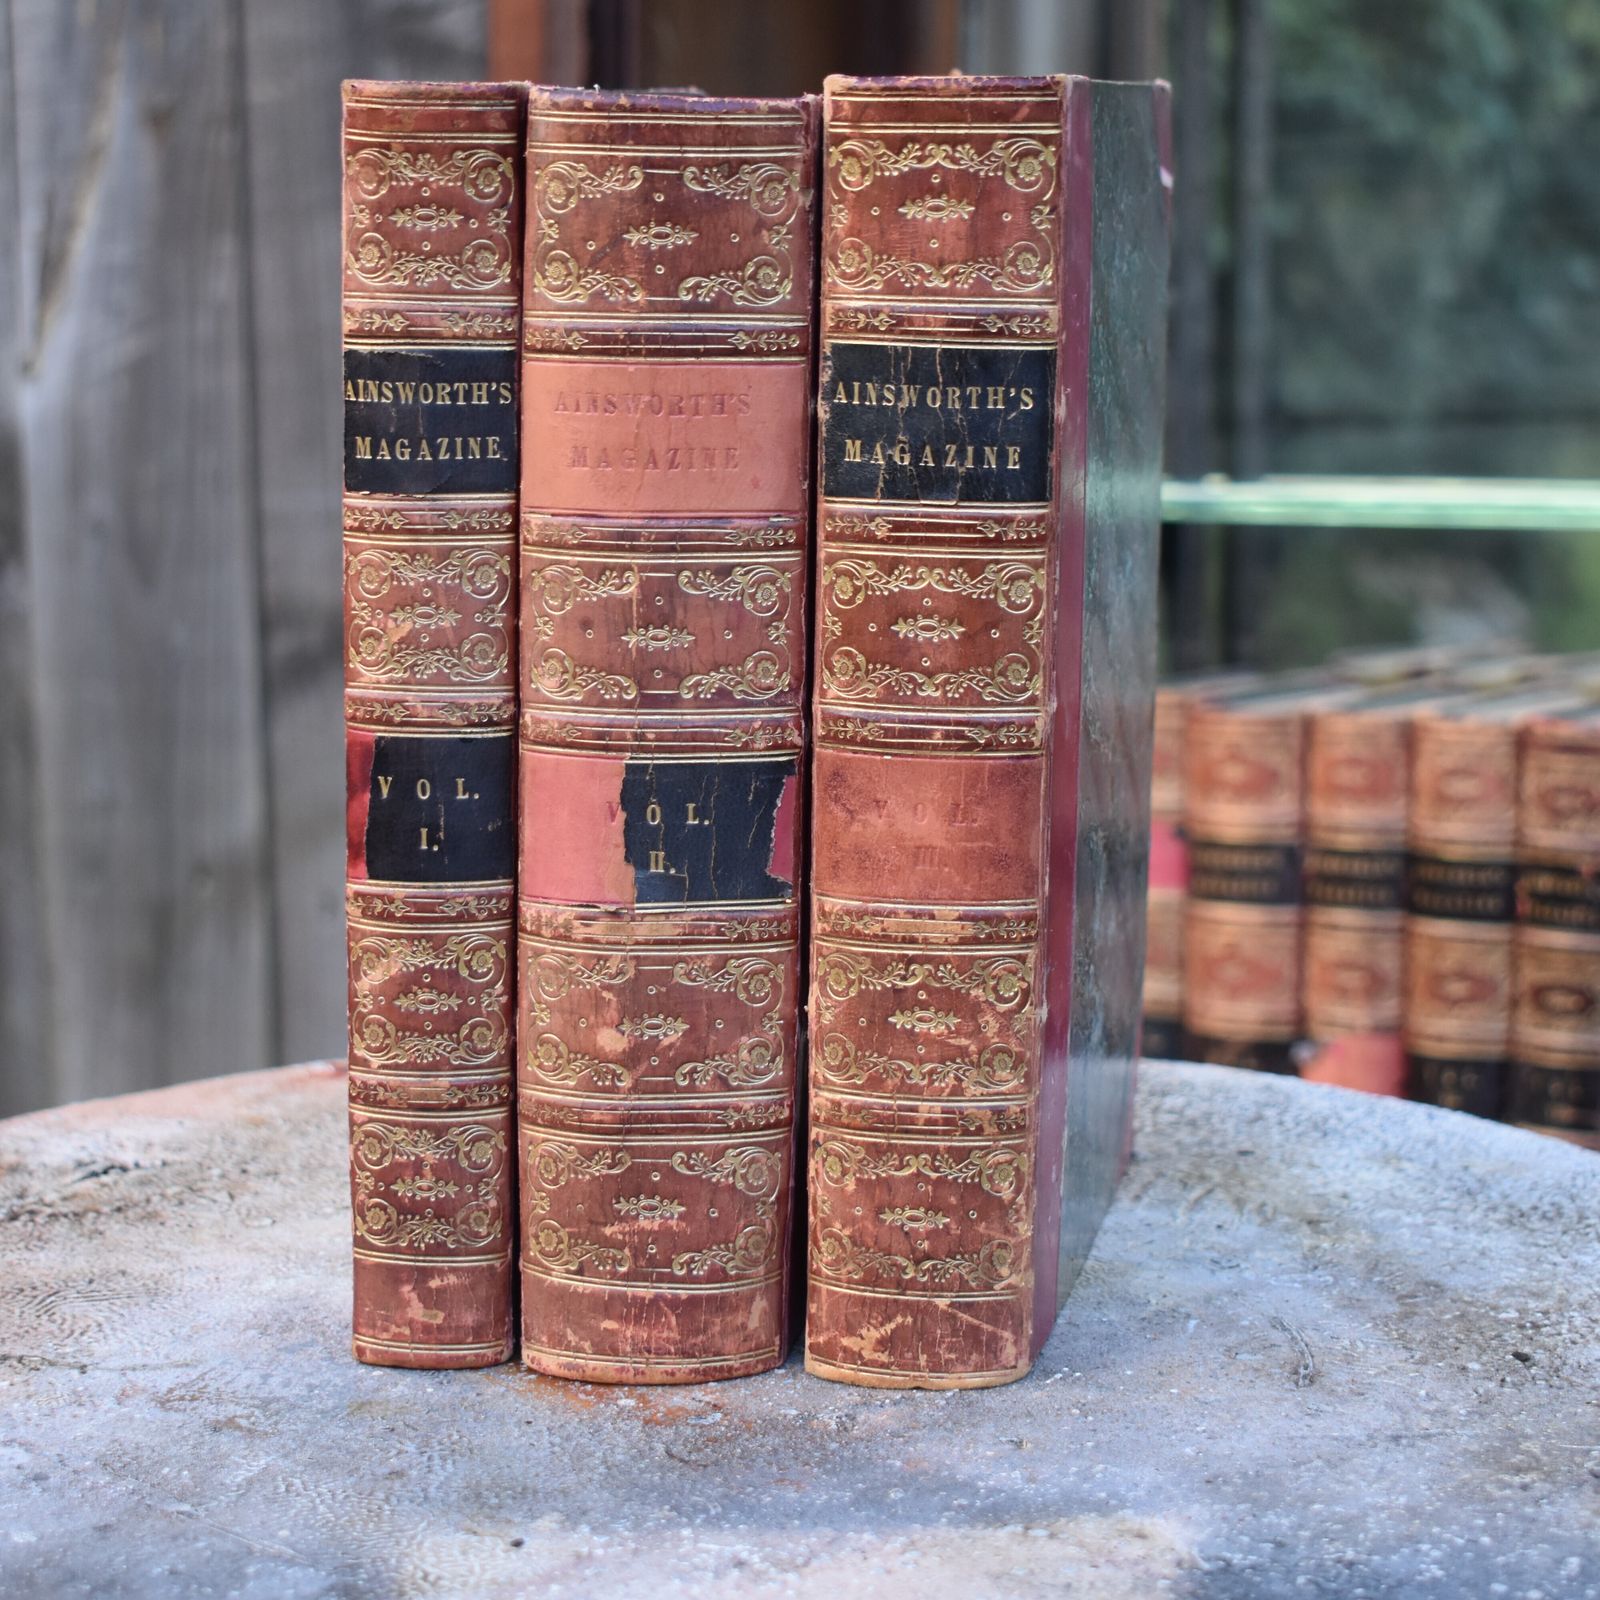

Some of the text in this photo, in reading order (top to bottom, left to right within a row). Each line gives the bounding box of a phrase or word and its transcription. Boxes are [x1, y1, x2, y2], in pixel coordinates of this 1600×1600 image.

[344, 379, 512, 405] AINSWORTH'S
[554, 391, 751, 418] AINSWORTH'S
[833, 381, 1035, 410] AINSWORTH'S
[355, 436, 501, 461] MAGAZINE
[569, 446, 740, 472] MAGAZINE
[844, 439, 1022, 469] MAGAZINE
